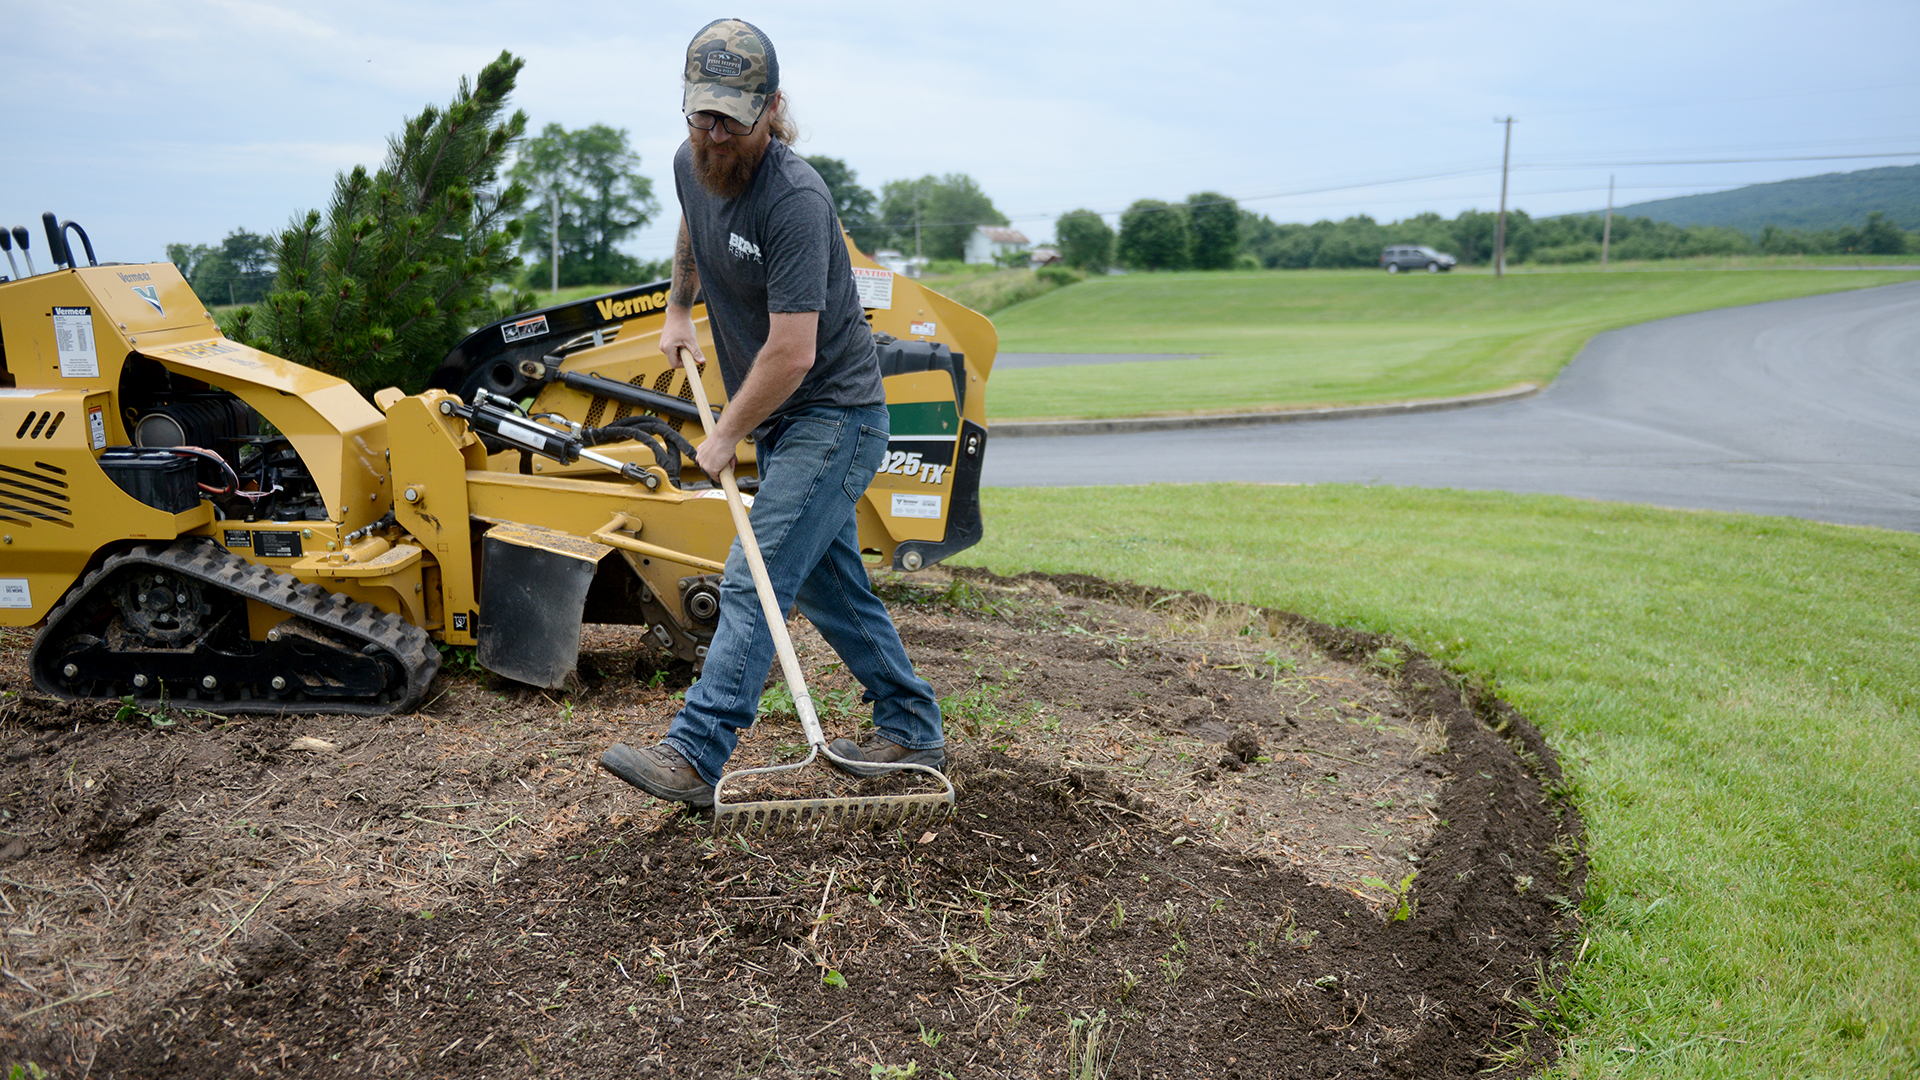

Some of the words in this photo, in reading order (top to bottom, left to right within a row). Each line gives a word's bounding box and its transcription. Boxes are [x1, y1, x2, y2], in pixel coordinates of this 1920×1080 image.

[116, 271, 151, 283] Vermeer
[854, 269, 892, 278] TENTION
[596, 289, 671, 321] Verme
